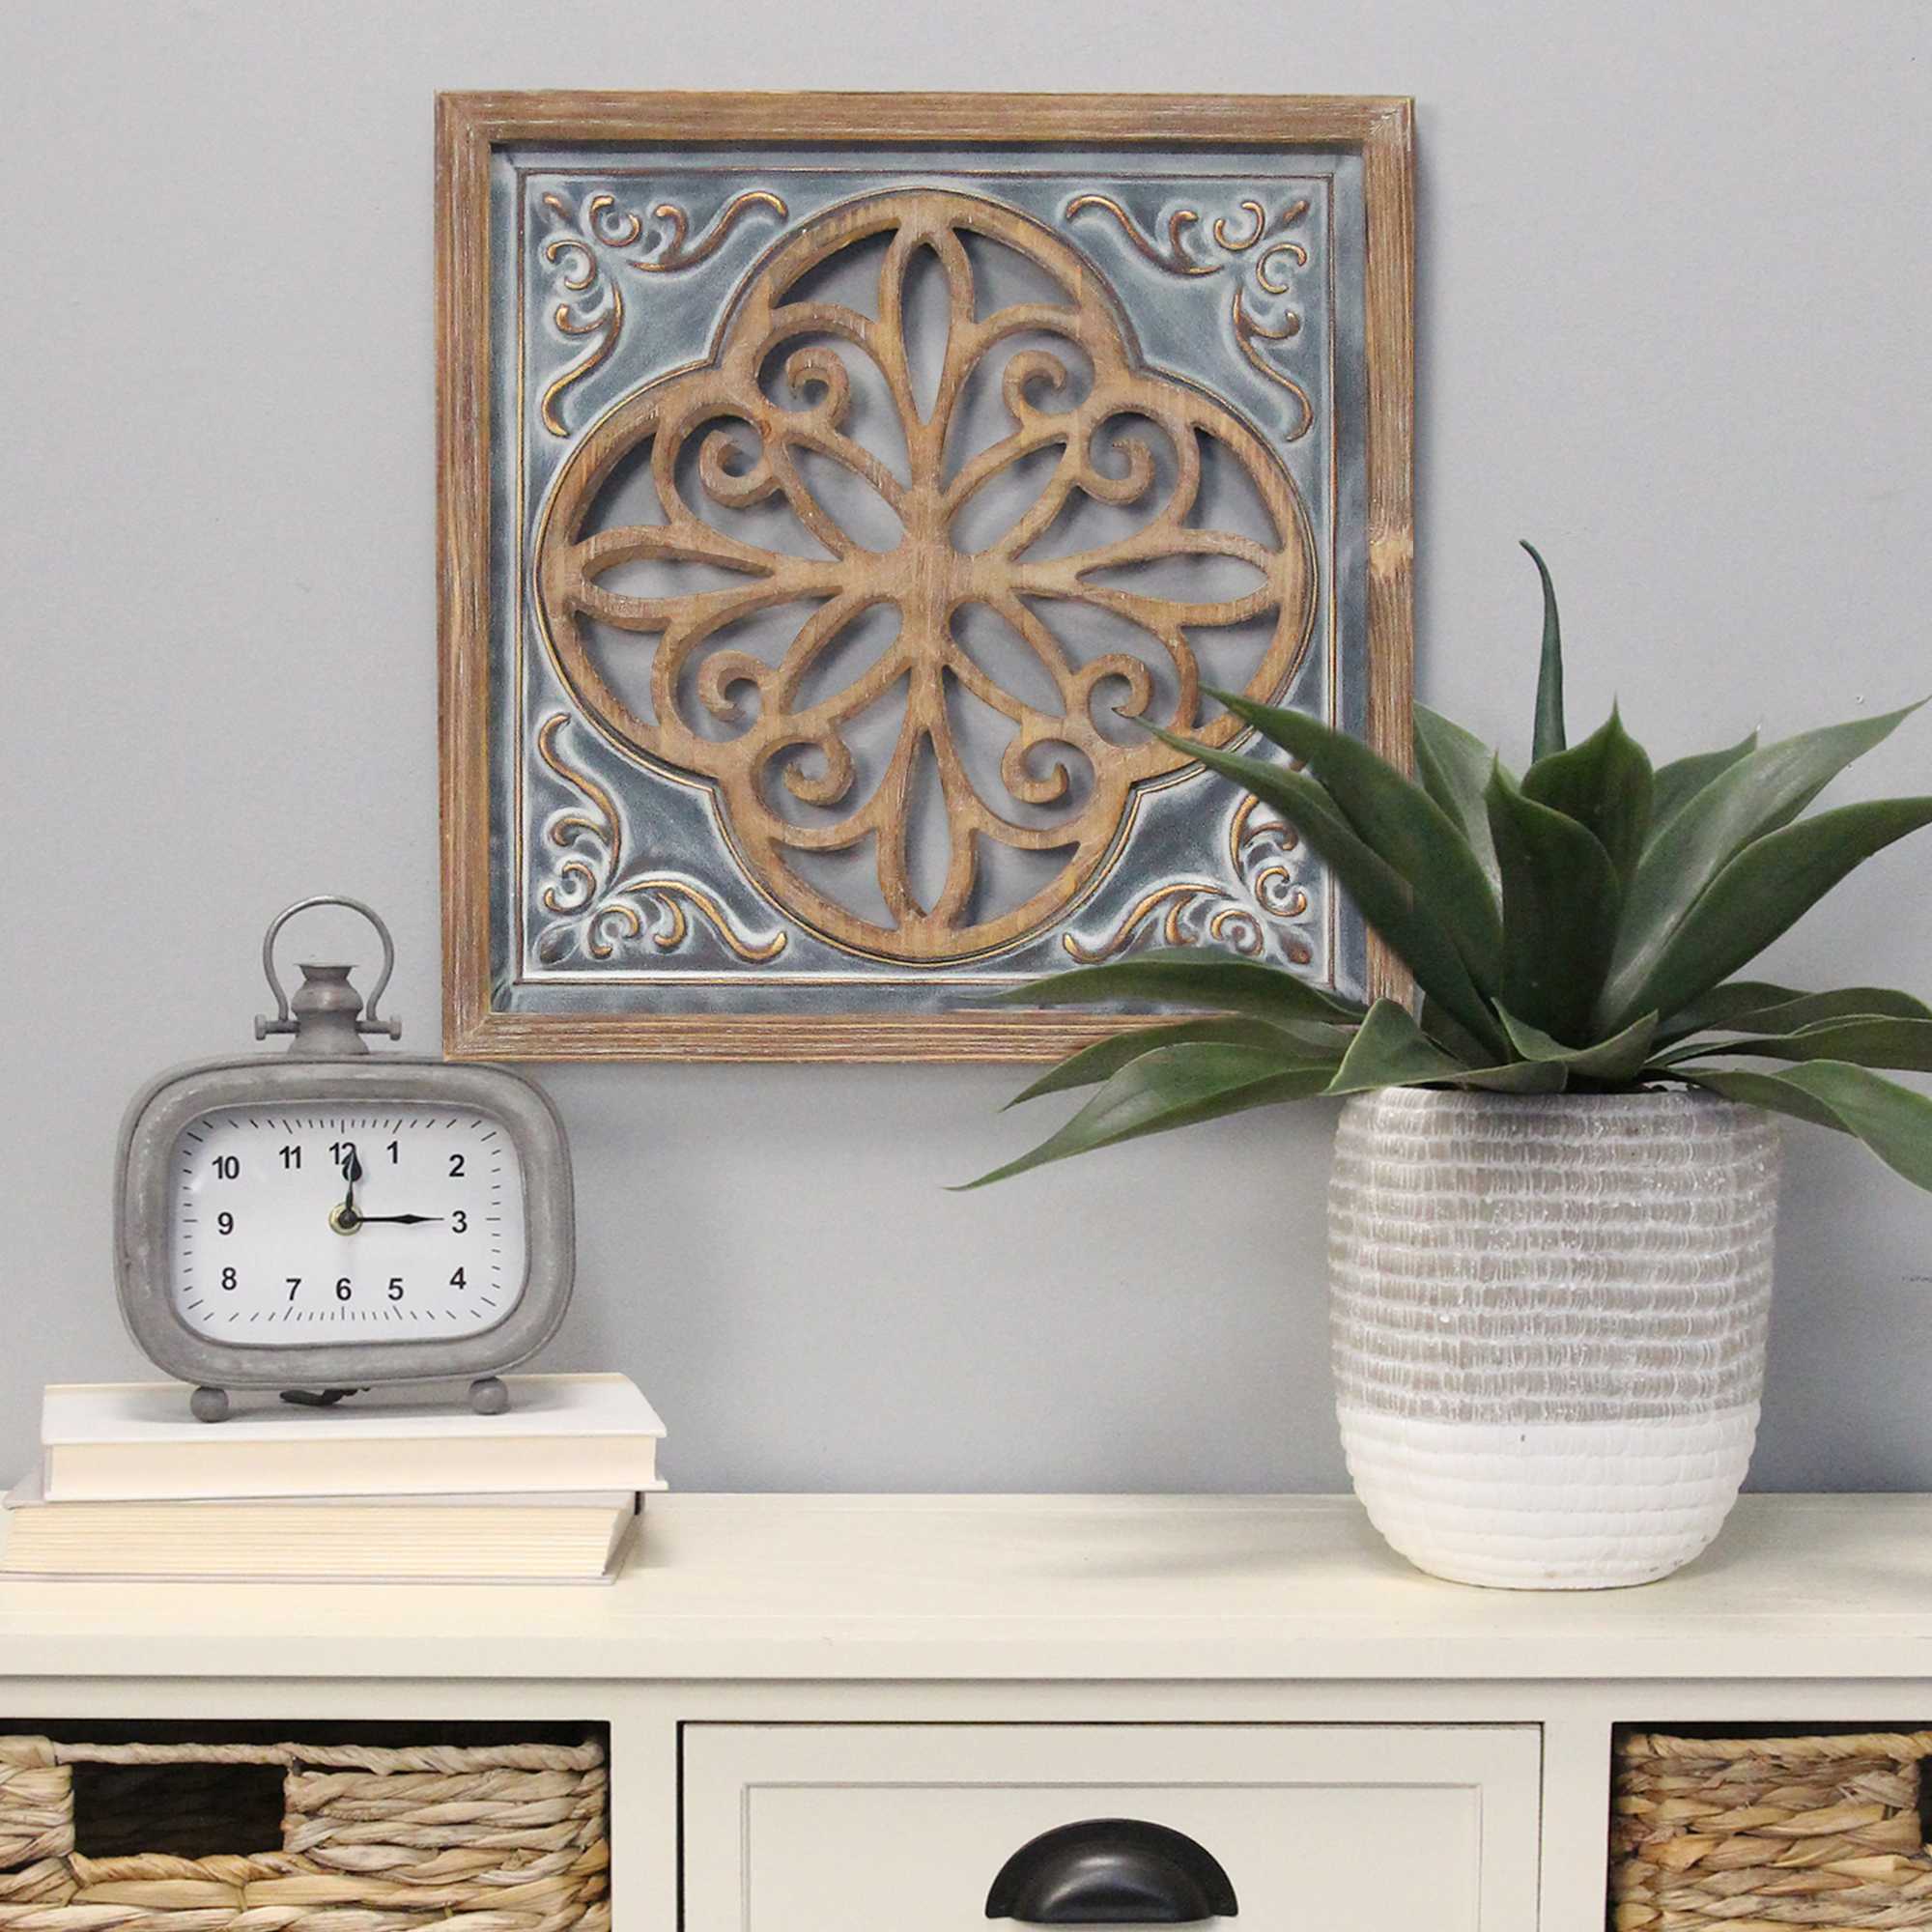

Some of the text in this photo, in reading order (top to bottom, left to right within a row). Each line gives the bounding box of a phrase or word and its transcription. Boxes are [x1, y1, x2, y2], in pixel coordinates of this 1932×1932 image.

[278, 1145, 301, 1170] 11
[386, 1140, 398, 1164] 1
[212, 1155, 241, 1180] 10
[448, 1153, 465, 1178] 2
[217, 1211, 234, 1236] 9
[451, 1209, 468, 1234] 3
[221, 1266, 238, 1291] 8
[285, 1278, 302, 1301] 7
[335, 1277, 352, 1301] 6
[387, 1277, 404, 1301] 5
[449, 1266, 467, 1290] 4
